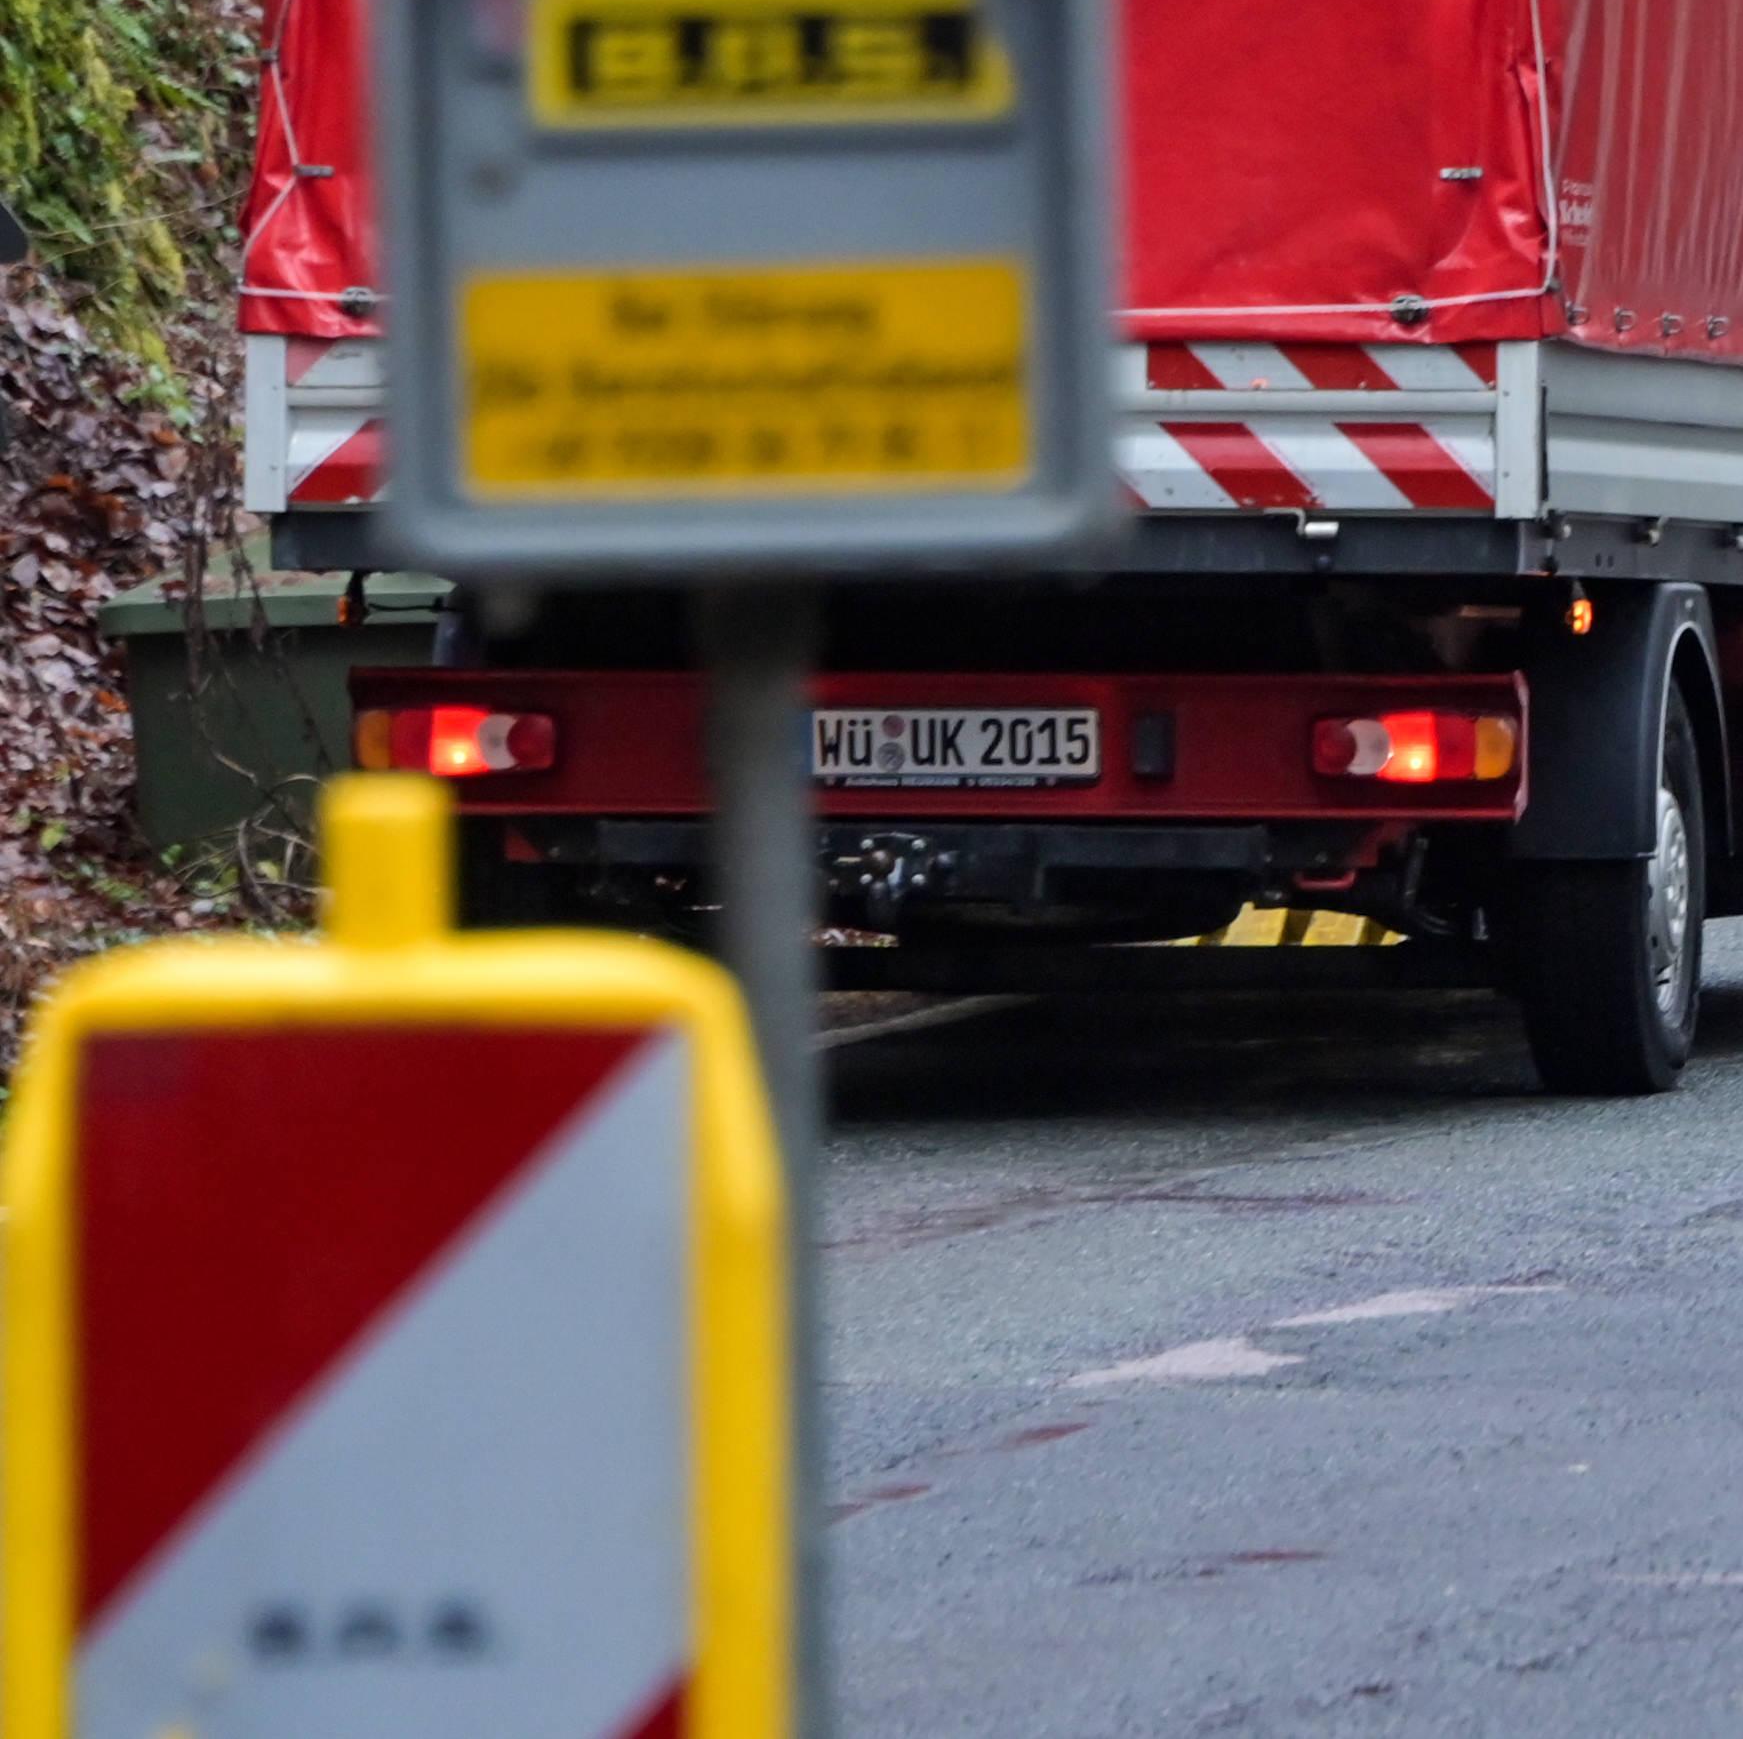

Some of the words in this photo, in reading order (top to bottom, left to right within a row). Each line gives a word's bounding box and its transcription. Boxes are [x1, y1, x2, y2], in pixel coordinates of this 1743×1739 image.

[818, 717, 873, 766] WÜ
[911, 717, 965, 766] UK
[979, 717, 1090, 766] 2015
